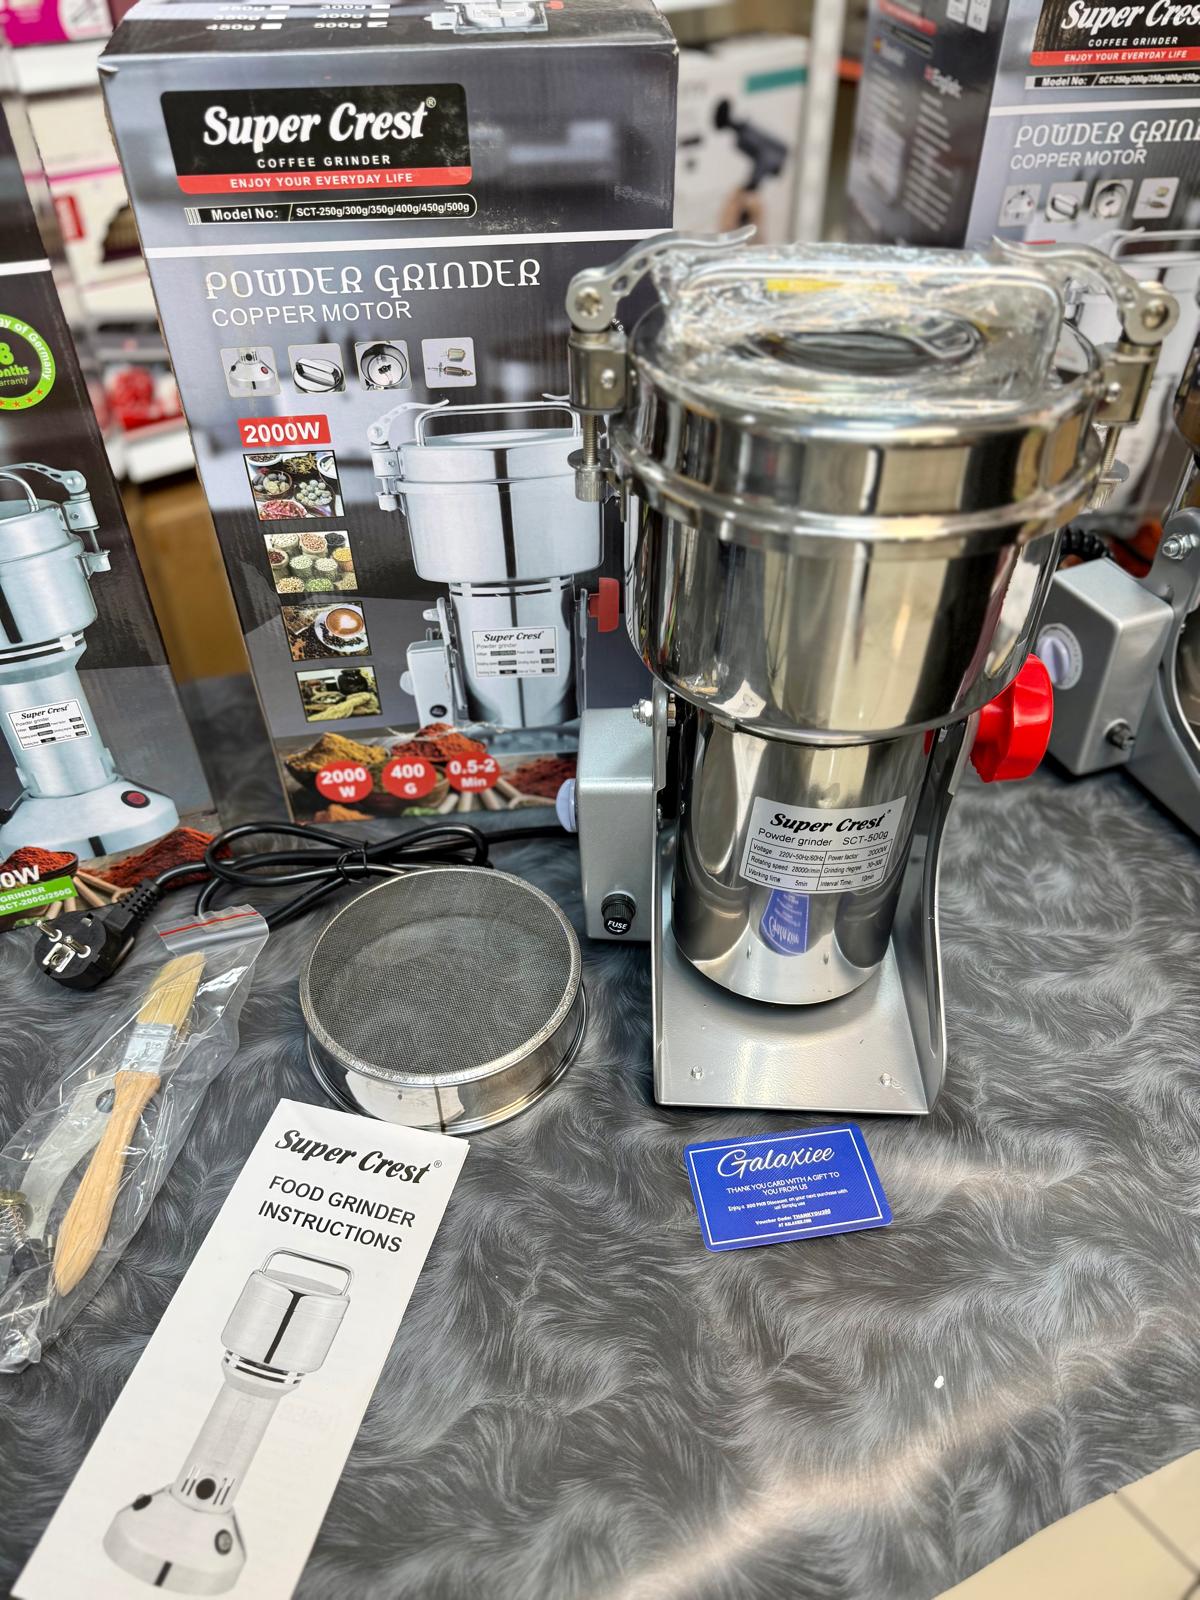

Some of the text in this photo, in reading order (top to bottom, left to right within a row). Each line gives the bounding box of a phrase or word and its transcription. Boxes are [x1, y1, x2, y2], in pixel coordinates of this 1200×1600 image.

[1061, 0, 1200, 35] Super Cres
[1088, 36, 1178, 47] COFFEE GRINDER
[1064, 50, 1188, 62] ENJOY YOUR EVERYDAY LIFE
[1041, 77, 1071, 86] Model
[1072, 76, 1087, 85] No:
[203, 101, 428, 153] Super Crest
[1014, 119, 1200, 148] POWDER GRIN
[257, 154, 391, 169] COFFEE GRINDER
[1010, 149, 1148, 170] COPPER MOTOR
[229, 172, 413, 189] ENJOY YOUR EVERYDAY LIFE
[211, 202, 470, 222] Model No: SCT-250g/300g/350g/400g/450g/500g
[205, 258, 541, 300] POWDER GRINDER
[211, 301, 413, 327] COPPER MOTOR
[243, 421, 320, 444] 2000W
[483, 632, 542, 643] Super Crest
[21, 705, 69, 720] Super Crest
[390, 763, 425, 779] 400
[450, 758, 496, 775] 0.5-2
[320, 767, 367, 785] 2000
[460, 776, 487, 788] Min
[338, 785, 356, 798] W
[404, 783, 418, 795] G
[770, 813, 886, 834] Super Crest
[758, 828, 889, 847] Powder grinder SCT-500g
[750, 855, 772, 868] Rotating
[773, 862, 789, 872] speed
[824, 866, 845, 874] Grinding
[748, 868, 769, 880] Working
[769, 873, 781, 883] time
[0, 887, 46, 902] GRINDER
[608, 920, 628, 930] FUSE
[274, 1129, 431, 1184] Super Crest
[717, 1147, 835, 1179] Galaxiee
[726, 1185, 751, 1194] THANK
[752, 1182, 766, 1191] YOU
[767, 1180, 785, 1188] CARD
[786, 1177, 807, 1185] WITH
[813, 1173, 828, 1181] GIFT
[762, 1188, 779, 1196] YOU
[779, 1185, 799, 1194] FROM
[269, 1175, 416, 1227] FOOD GRINDER
[258, 1200, 403, 1253] INSTRUCTIONS
